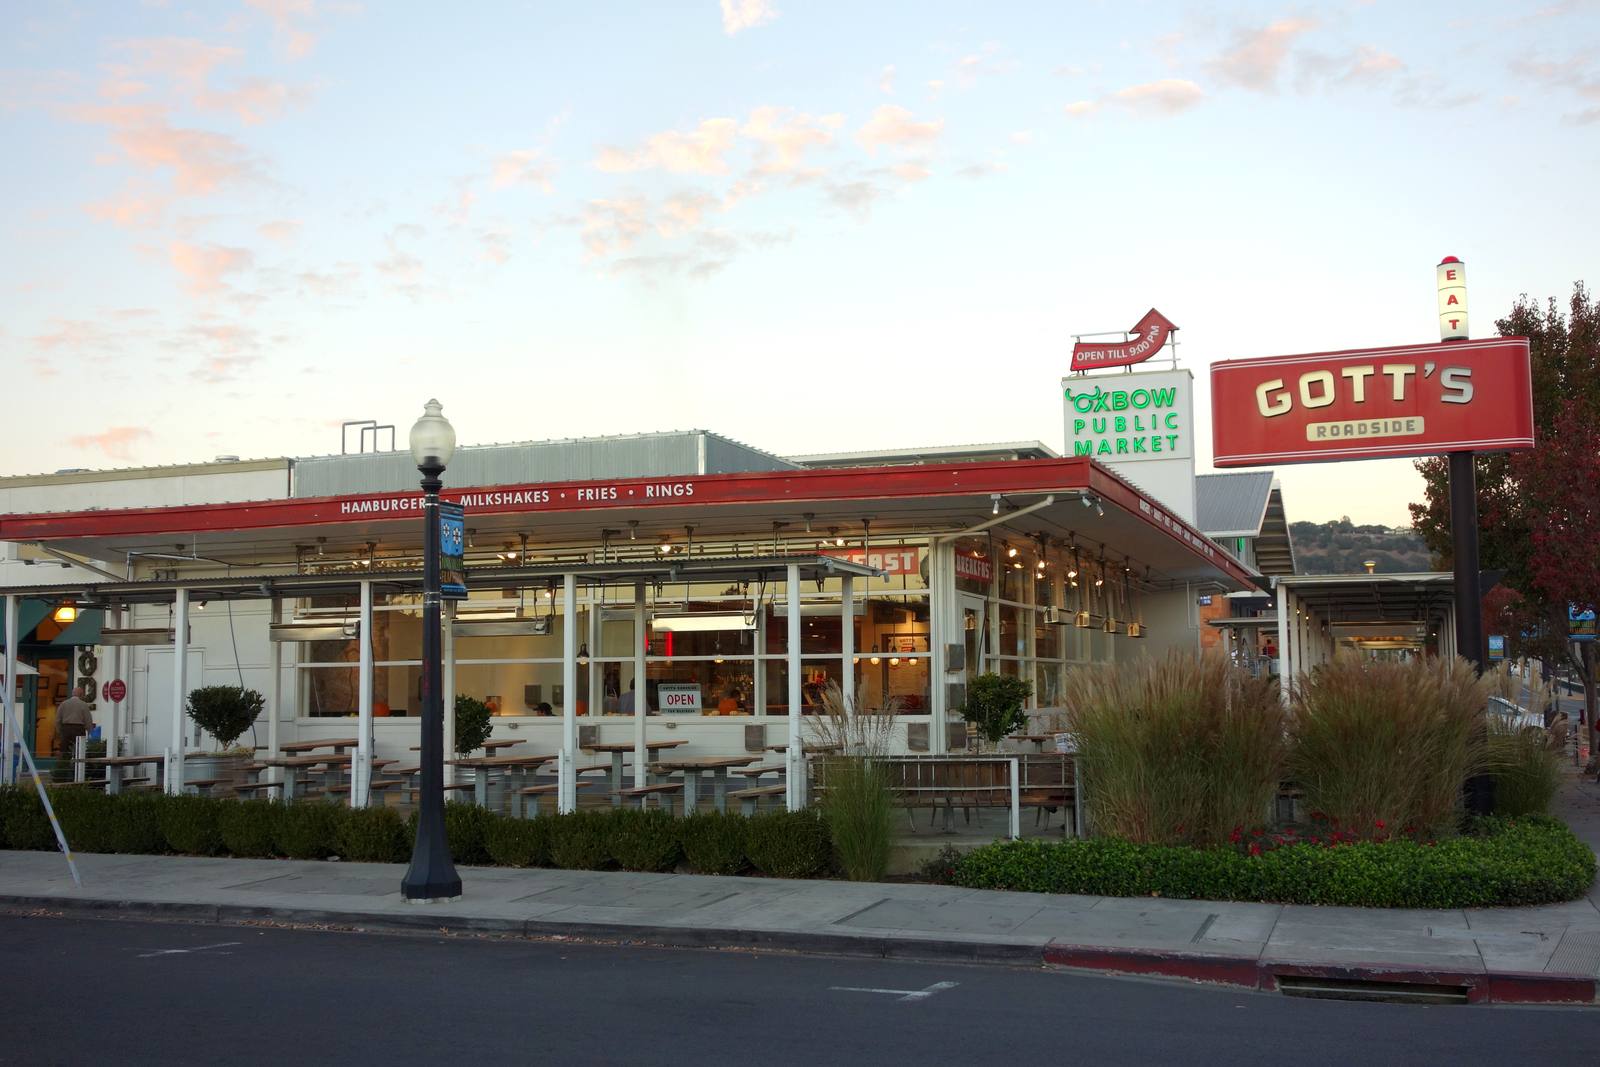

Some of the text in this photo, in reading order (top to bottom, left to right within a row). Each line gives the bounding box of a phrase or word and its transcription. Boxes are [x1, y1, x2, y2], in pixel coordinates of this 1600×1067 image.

[1446, 269, 1460, 330] EAT
[1076, 325, 1160, 361] OPEN TILL 9:00 PM
[1065, 386, 1176, 412] OXBOW
[1256, 362, 1474, 417] GOTT'S
[1074, 413, 1178, 434] PUBLIC
[1317, 420, 1416, 438] ROADSIDE
[1074, 435, 1178, 456] MARKET
[460, 491, 549, 507] MILKSHAKES
[578, 488, 616, 501] FRIES
[646, 483, 694, 497] RINGS
[667, 694, 694, 706] OPEN
